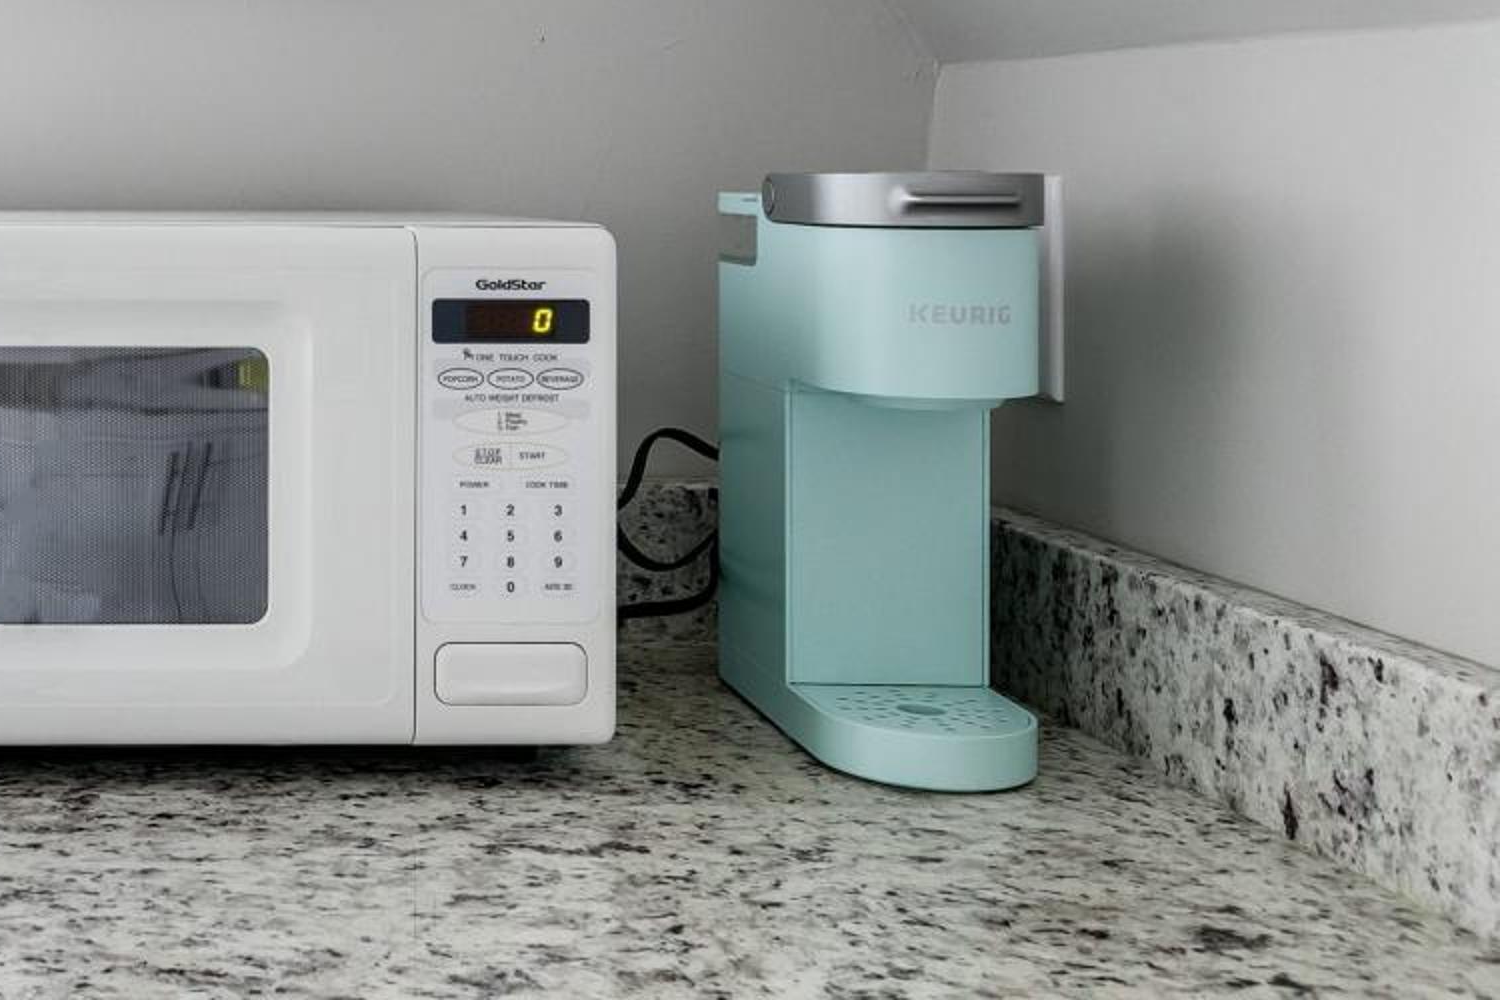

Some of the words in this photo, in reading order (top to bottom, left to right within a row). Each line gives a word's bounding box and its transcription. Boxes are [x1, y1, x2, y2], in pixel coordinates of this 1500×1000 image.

[475, 279, 546, 291] GoldStar
[533, 308, 553, 332] 0
[908, 305, 1012, 325] KEURIG
[499, 353, 529, 361] TOUCH
[461, 504, 467, 515] 1
[506, 504, 515, 516] 2
[554, 504, 563, 516] 3
[459, 530, 468, 541] 4
[507, 530, 515, 542] 5
[554, 530, 563, 542] 6
[460, 556, 468, 567] 7
[507, 556, 515, 568] 8
[554, 556, 563, 568] 9
[506, 581, 515, 593] 0
